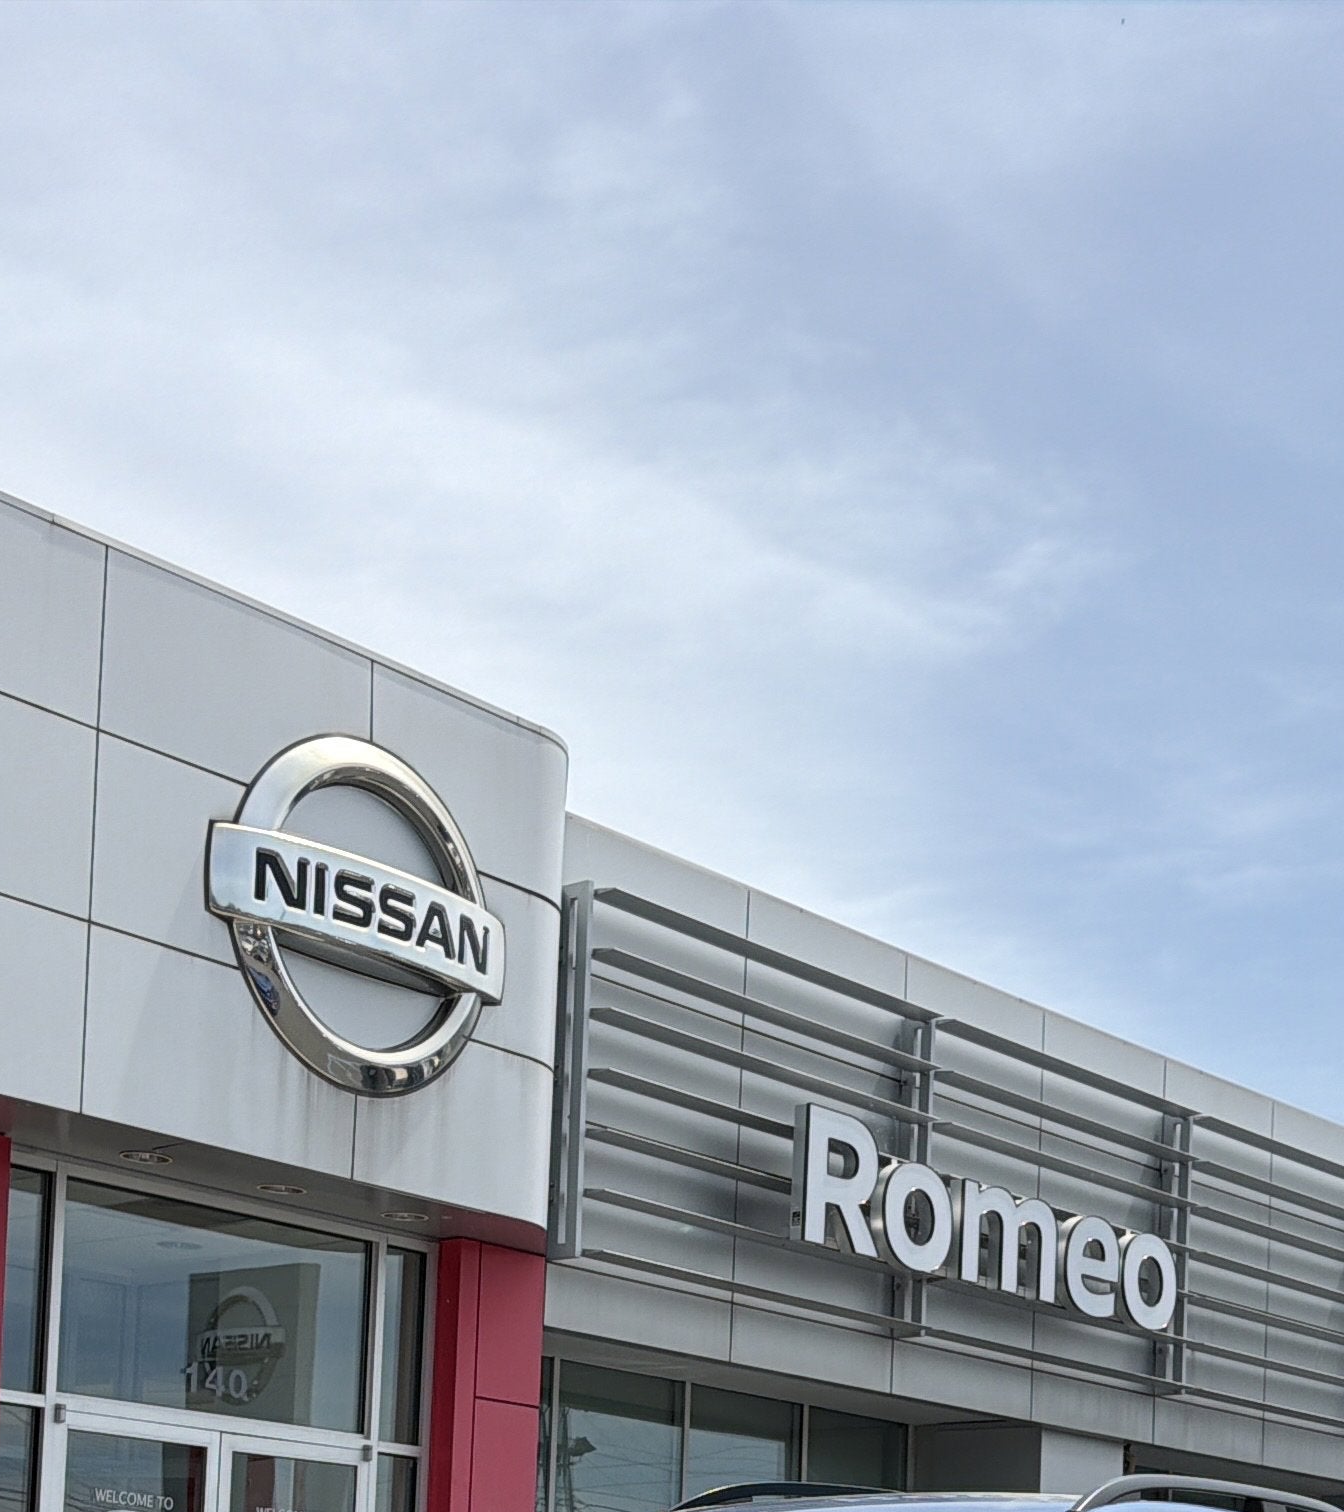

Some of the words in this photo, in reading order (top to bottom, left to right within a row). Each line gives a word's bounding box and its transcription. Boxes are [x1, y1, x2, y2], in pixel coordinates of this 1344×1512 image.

[253, 846, 492, 976] NISSAN
[796, 1103, 1177, 1330] Romeo
[95, 1487, 154, 1508] WELCOME
[157, 1496, 174, 1511] TO
